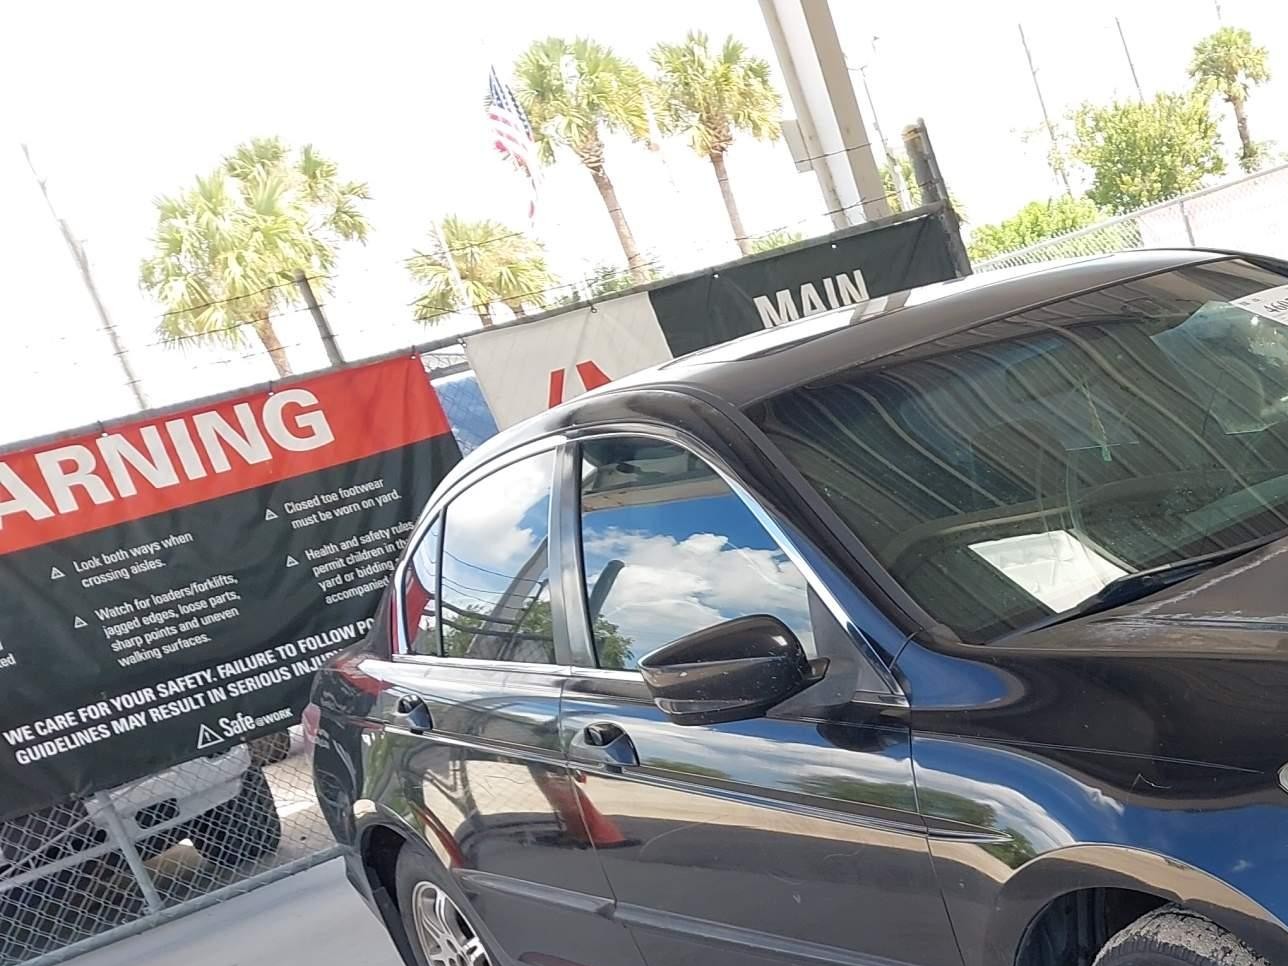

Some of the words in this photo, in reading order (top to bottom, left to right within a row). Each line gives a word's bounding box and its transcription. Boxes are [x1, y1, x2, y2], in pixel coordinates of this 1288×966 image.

[753, 269, 870, 328] MAIN
[284, 496, 320, 515] Closed
[321, 492, 339, 503] toe
[339, 479, 385, 499] footwear
[291, 514, 320, 530] must
[319, 509, 333, 522] be
[333, 503, 361, 518] worn
[361, 499, 375, 509] on
[375, 489, 402, 508] yard.
[73, 557, 101, 573] Look
[103, 549, 130, 564] both
[130, 541, 161, 558] ways
[161, 531, 194, 549] when
[305, 542, 340, 562] Health
[340, 535, 360, 551] and
[360, 528, 391, 544] safety
[391, 520, 415, 535] rules
[312, 559, 345, 577] permit
[346, 547, 385, 566] children
[385, 543, 396, 553] in
[82, 566, 130, 588] crossing
[130, 558, 166, 574] aisles.
[317, 574, 344, 593] yard
[344, 571, 355, 582] or
[356, 560, 395, 577] bidding
[325, 574, 390, 605] accompanied
[95, 599, 134, 622] Watch
[134, 596, 152, 611] for
[152, 573, 238, 605] loaders/forklifts,
[103, 617, 141, 639] jagged
[142, 609, 179, 627] edges,
[178, 598, 208, 615] loose
[208, 590, 241, 610] parts,
[111, 635, 144, 653] sharp
[144, 624, 178, 643] points
[178, 616, 200, 632] and
[200, 607, 240, 626] uneven
[118, 648, 162, 668] walking
[162, 632, 212, 654] surfaces.
[3, 727, 35, 746] WE
[34, 711, 79, 736] CARE
[77, 701, 112, 723] FOR
[109, 687, 157, 713] YOUR
[156, 668, 217, 700] SAFETY.
[216, 649, 276, 679] FAILURE
[276, 643, 297, 660] TO
[297, 624, 356, 654] FOLLOW
[15, 723, 112, 765] GUIDELINES
[111, 712, 149, 735] MAY
[147, 693, 208, 722] RESULT
[208, 688, 228, 705] IN
[228, 667, 292, 697] SERIOUS
